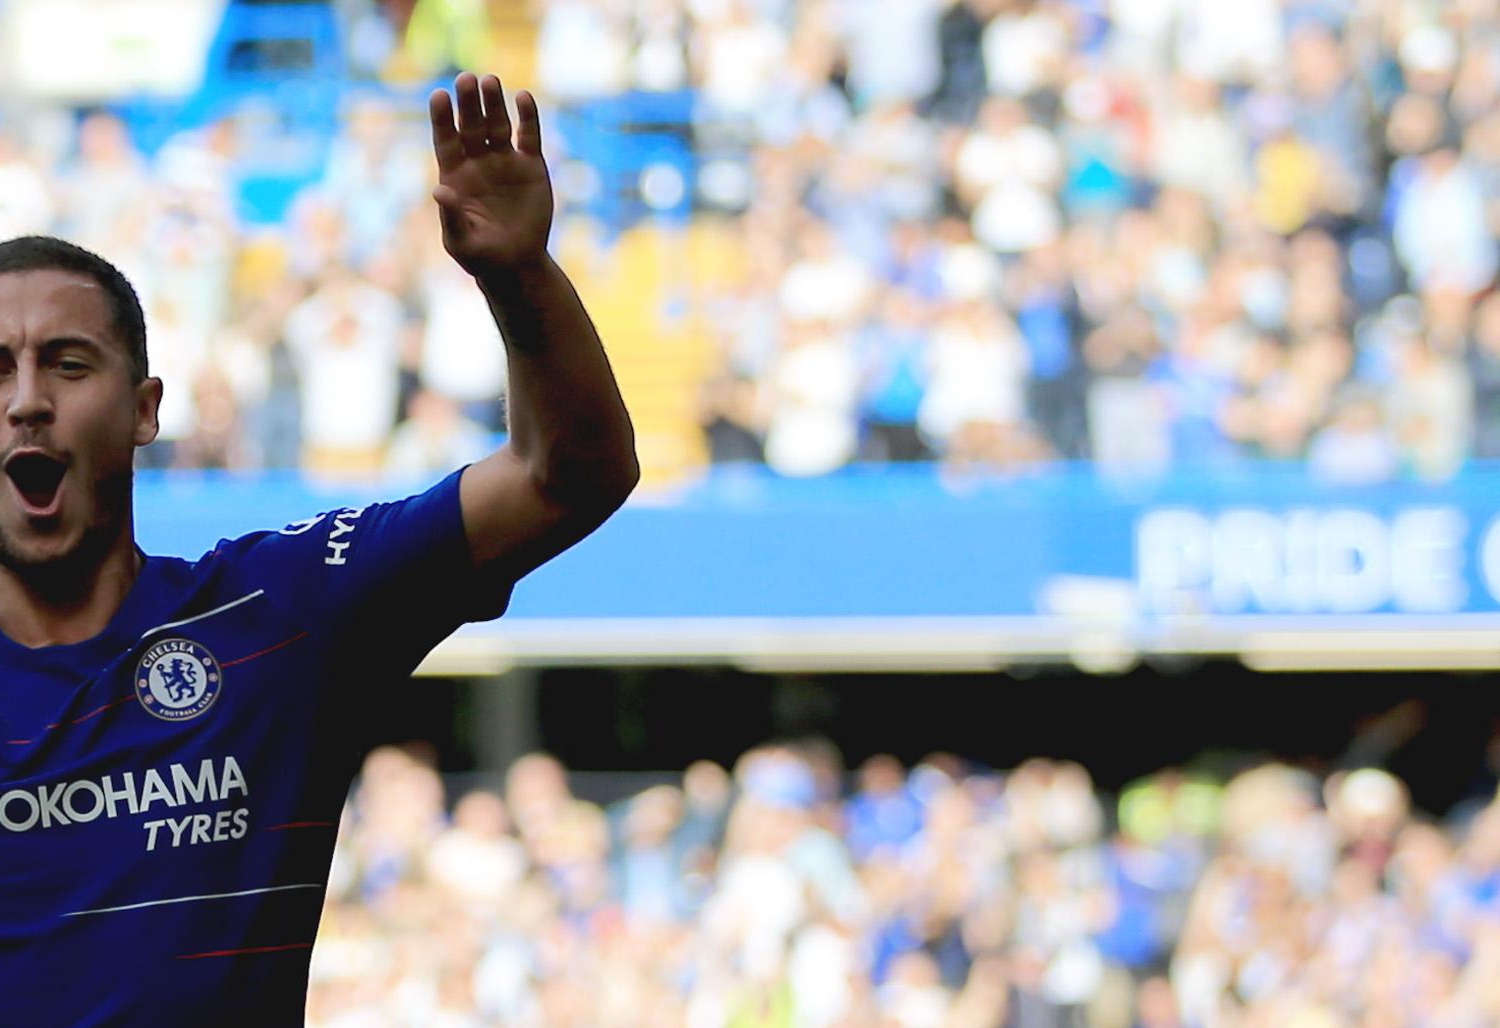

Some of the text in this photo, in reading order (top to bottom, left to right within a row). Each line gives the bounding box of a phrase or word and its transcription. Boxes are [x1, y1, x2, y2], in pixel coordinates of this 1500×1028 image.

[1137, 508, 1469, 615] PRIDE
[143, 642, 195, 668] CHELSEA
[143, 808, 248, 851] TYRES
